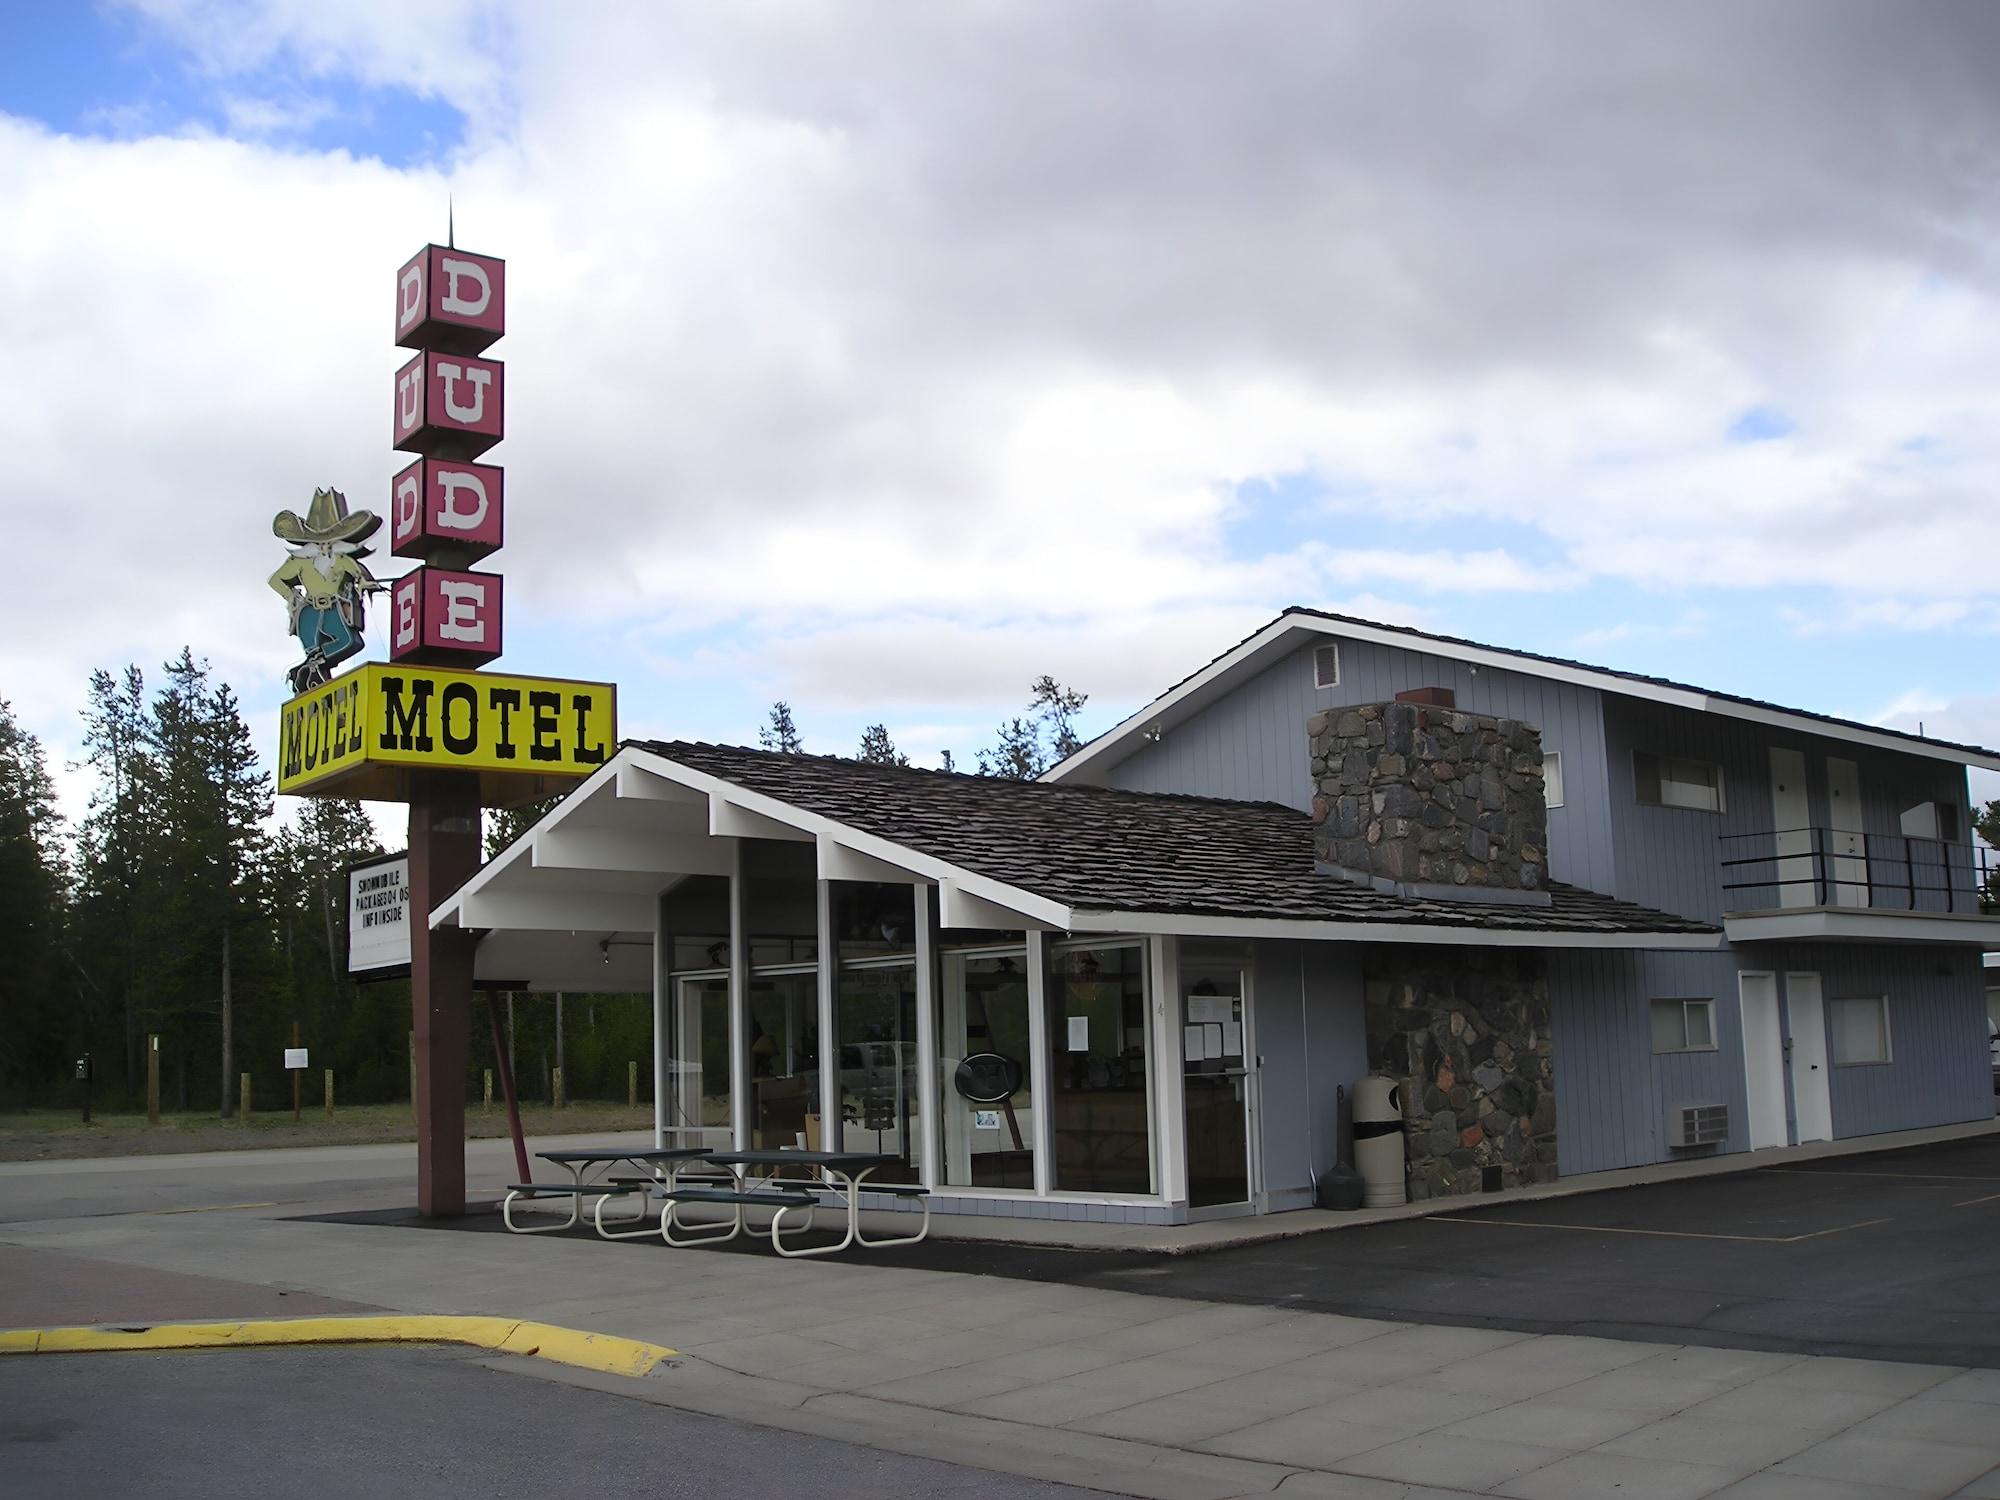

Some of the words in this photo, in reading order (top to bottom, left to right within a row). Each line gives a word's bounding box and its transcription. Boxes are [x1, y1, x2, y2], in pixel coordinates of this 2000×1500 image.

[397, 264, 422, 649] DUDE
[437, 256, 492, 644] DUDE
[284, 679, 363, 781] MOTEL
[379, 676, 605, 765] MOTEL
